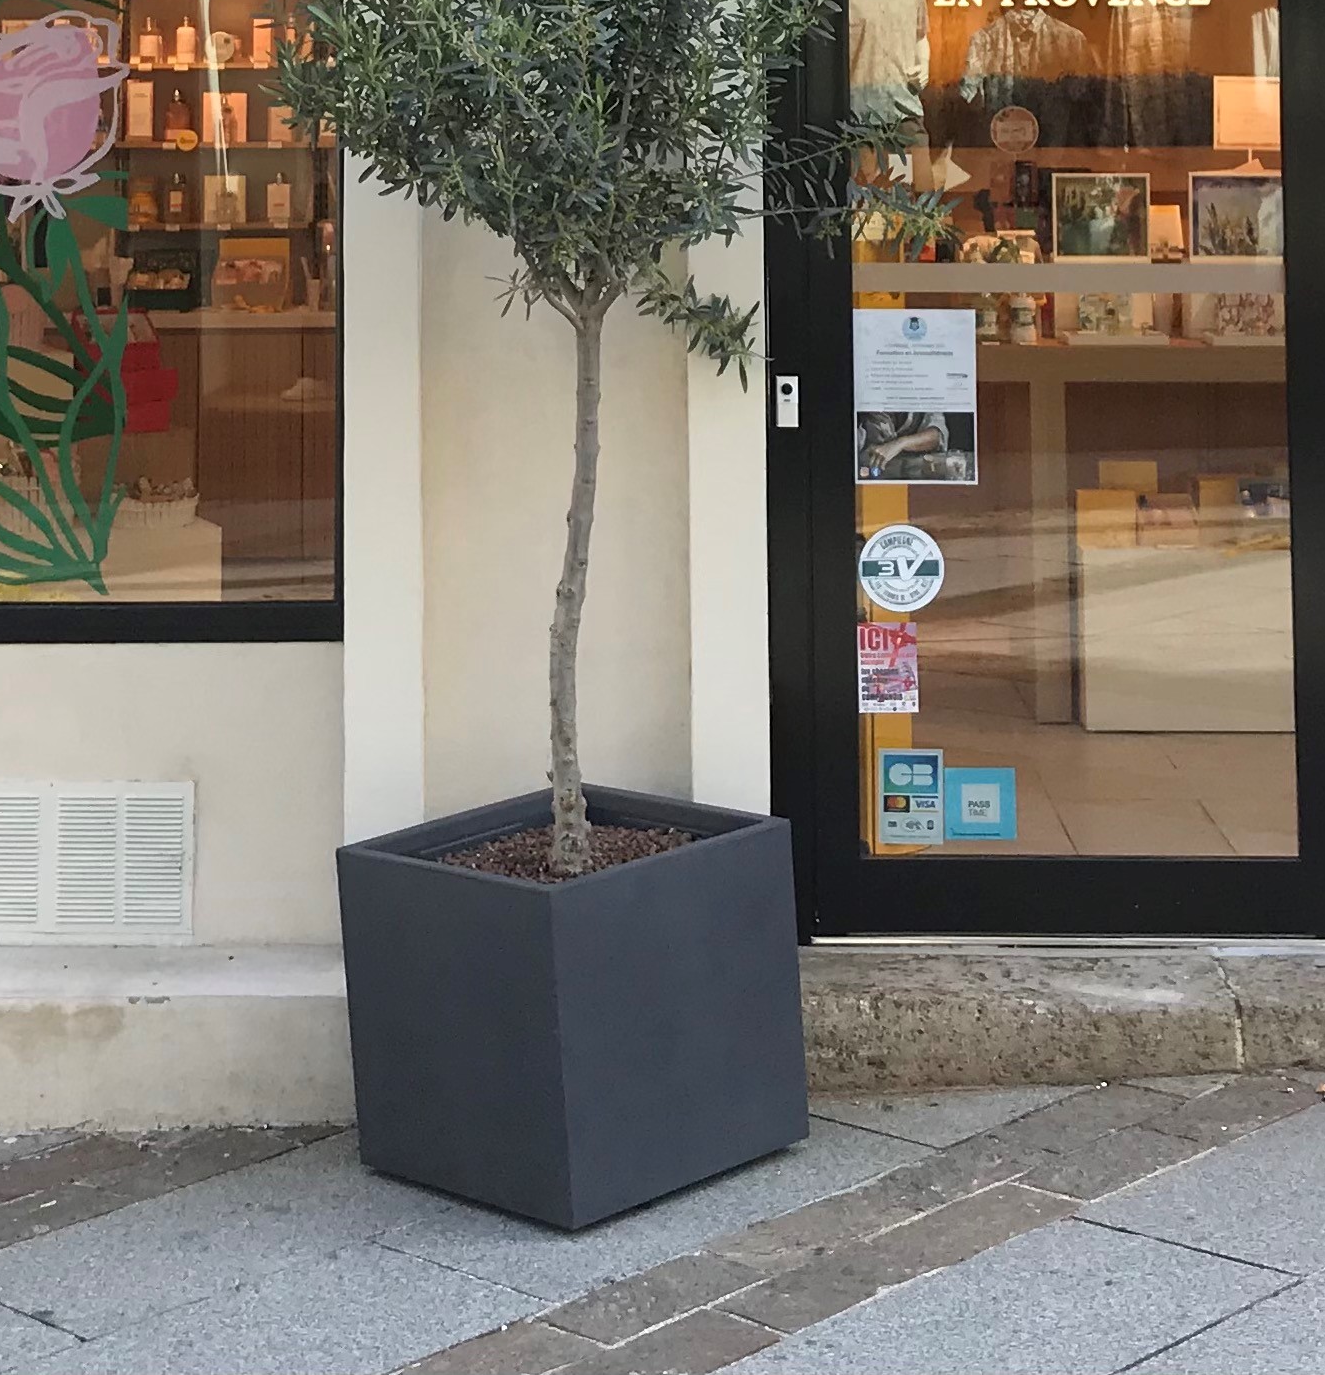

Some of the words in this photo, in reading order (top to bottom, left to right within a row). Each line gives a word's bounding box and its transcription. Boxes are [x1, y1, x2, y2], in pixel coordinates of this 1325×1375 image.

[859, 627, 889, 652] ICI
[915, 799, 936, 809] VISA
[967, 800, 991, 809] PASS
